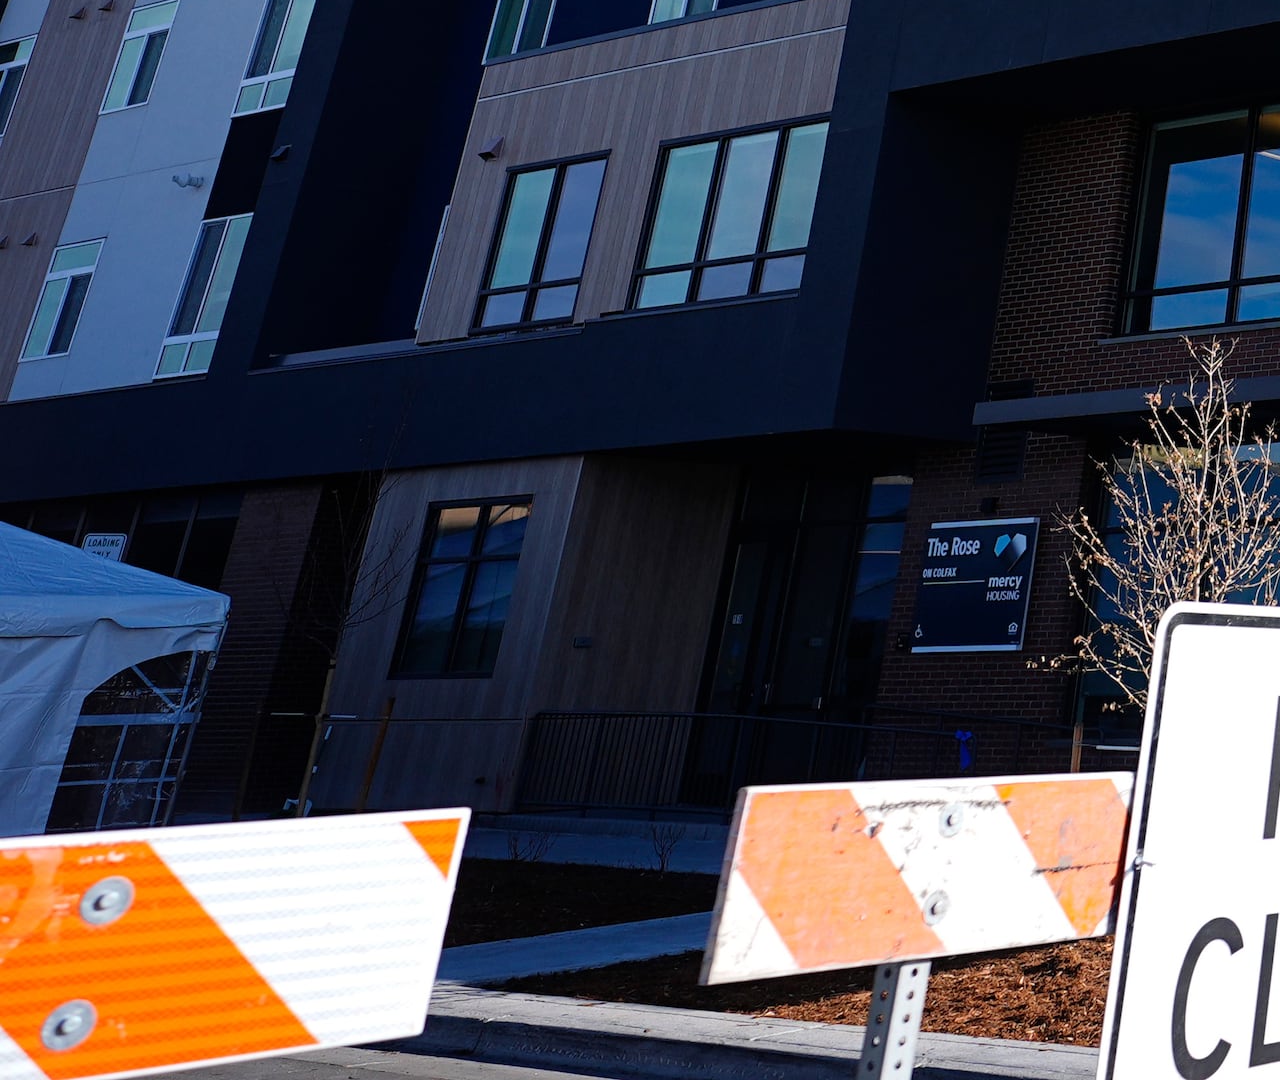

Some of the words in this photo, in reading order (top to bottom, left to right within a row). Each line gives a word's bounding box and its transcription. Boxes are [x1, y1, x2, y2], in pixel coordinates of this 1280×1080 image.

[88, 538, 120, 547] LOADING
[928, 538, 949, 557] The
[951, 536, 981, 556] Rose
[923, 569, 933, 578] ON
[933, 567, 958, 577] COLFAX
[988, 576, 1023, 589] mercy
[986, 590, 1020, 601] HOUSING
